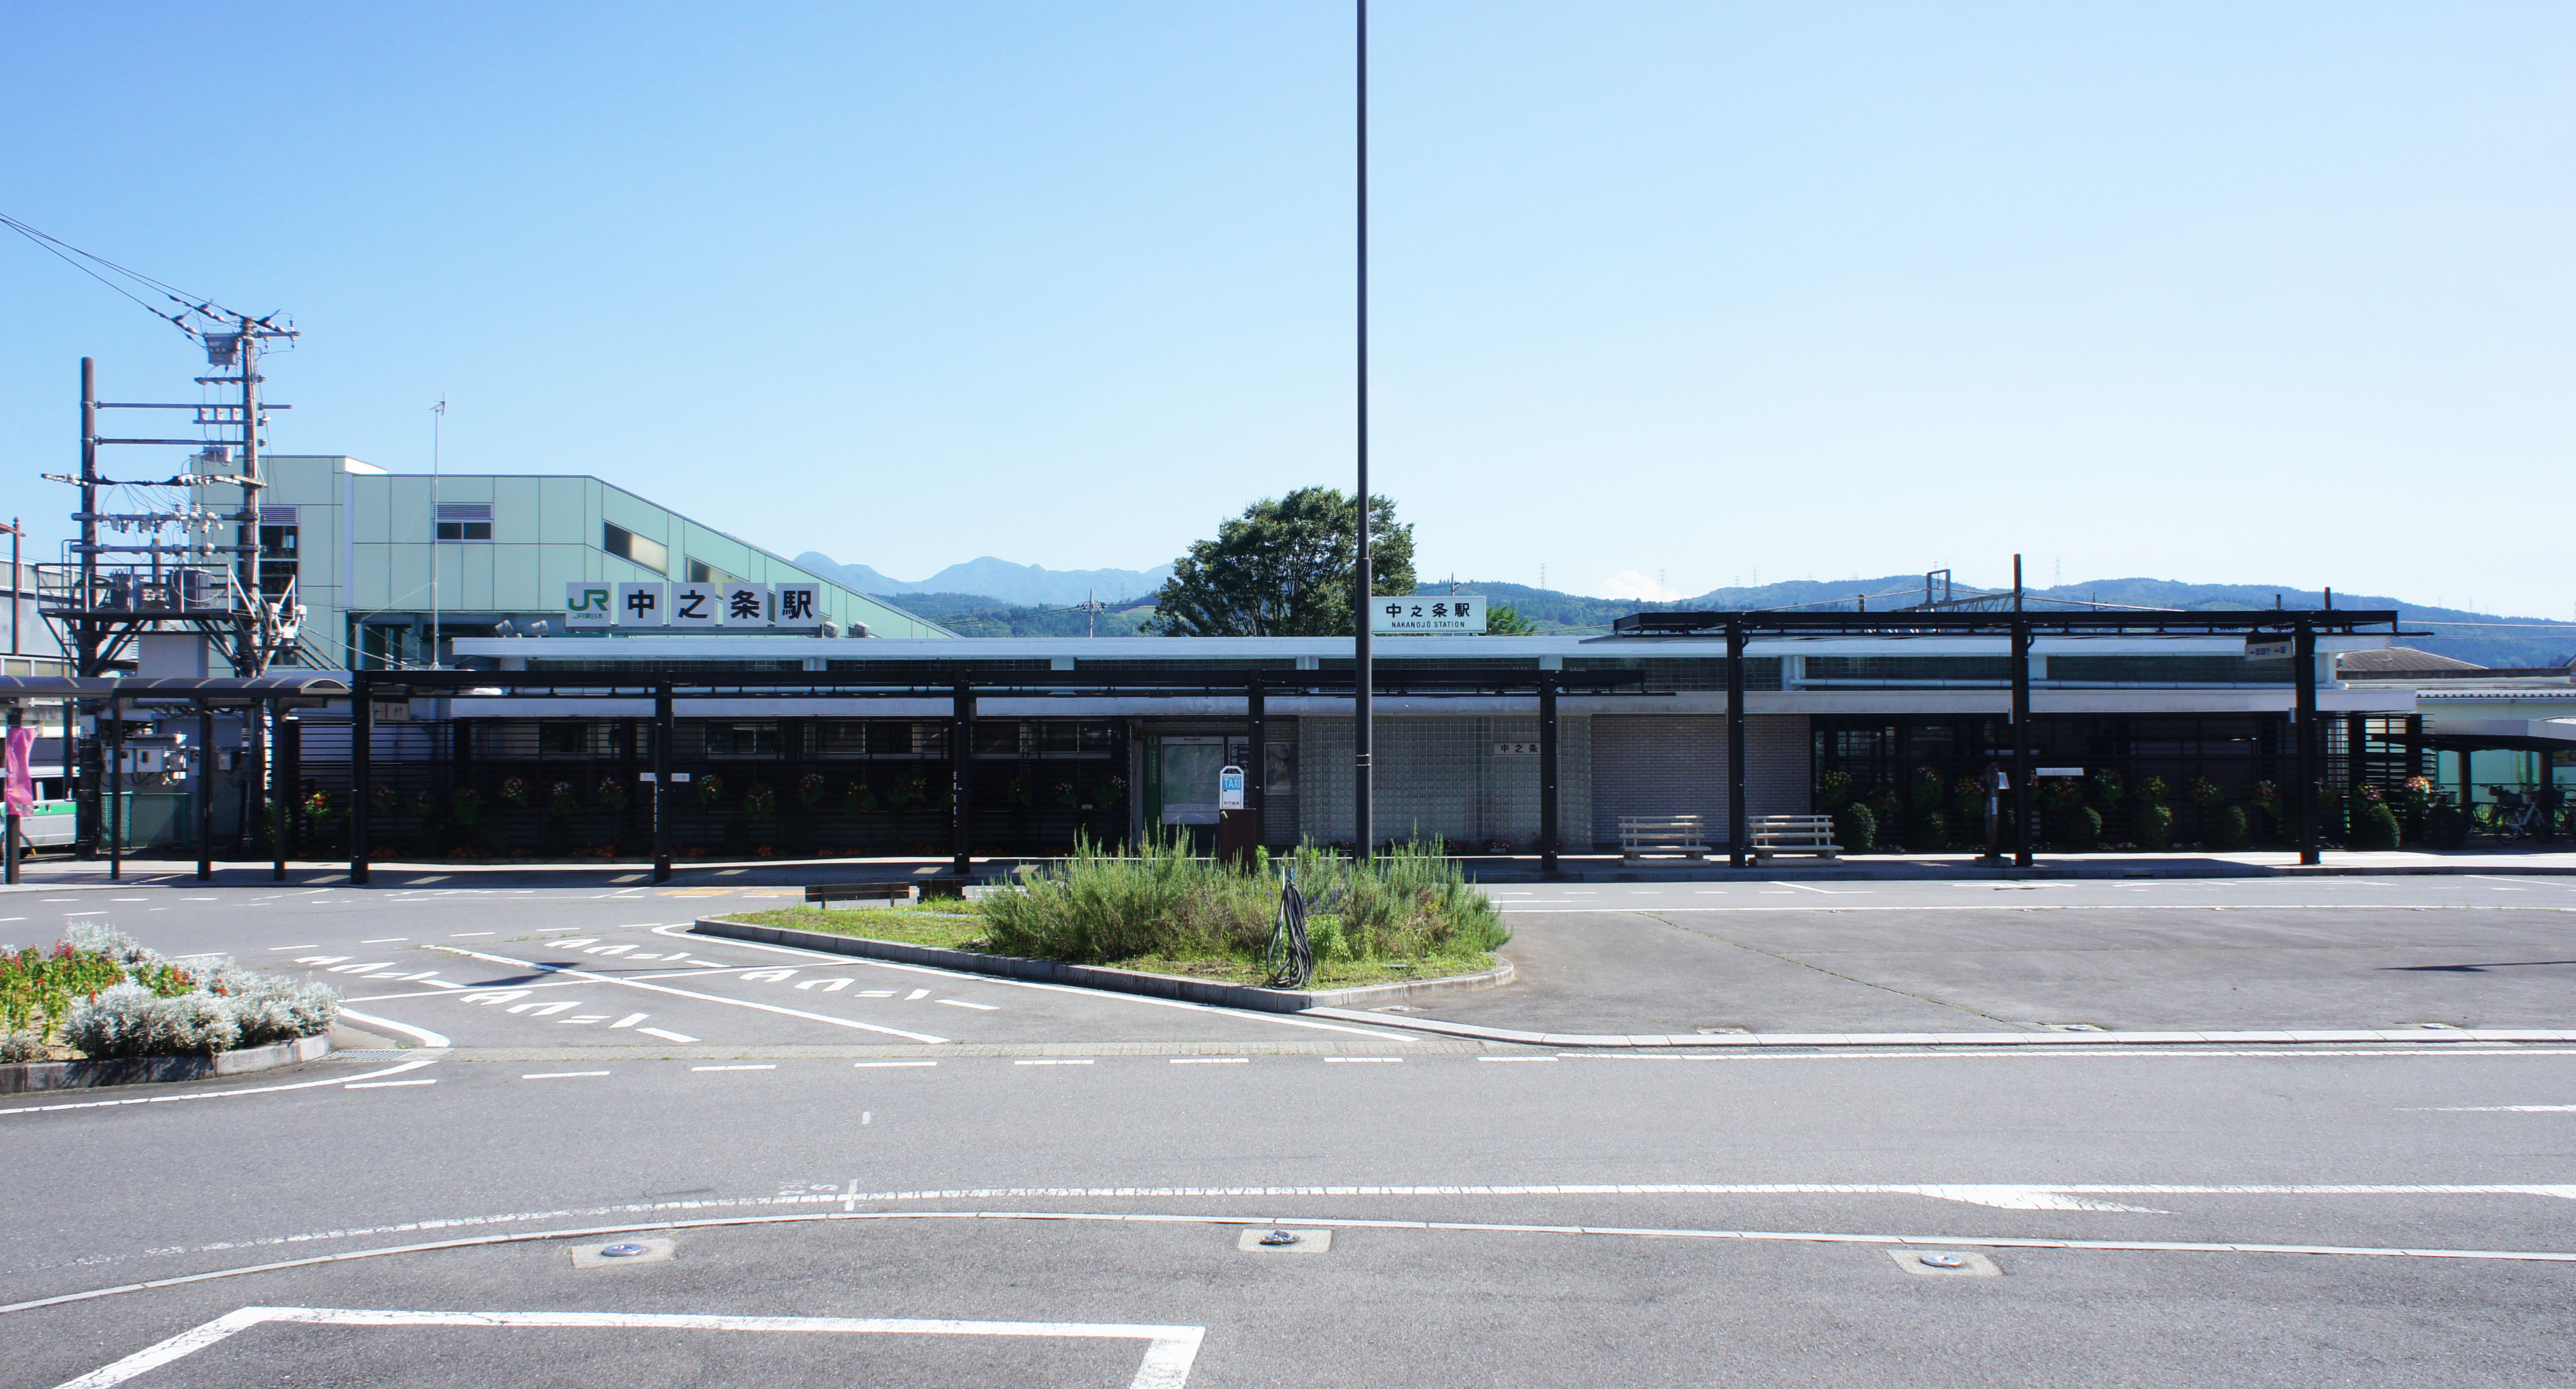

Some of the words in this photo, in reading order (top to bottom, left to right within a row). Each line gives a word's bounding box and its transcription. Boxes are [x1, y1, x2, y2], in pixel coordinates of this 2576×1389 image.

[568, 589, 609, 612] JR
[627, 589, 814, 619] 中之条駅
[1386, 603, 1470, 618] 中之条駅
[1224, 778, 1241, 789] TAXI
